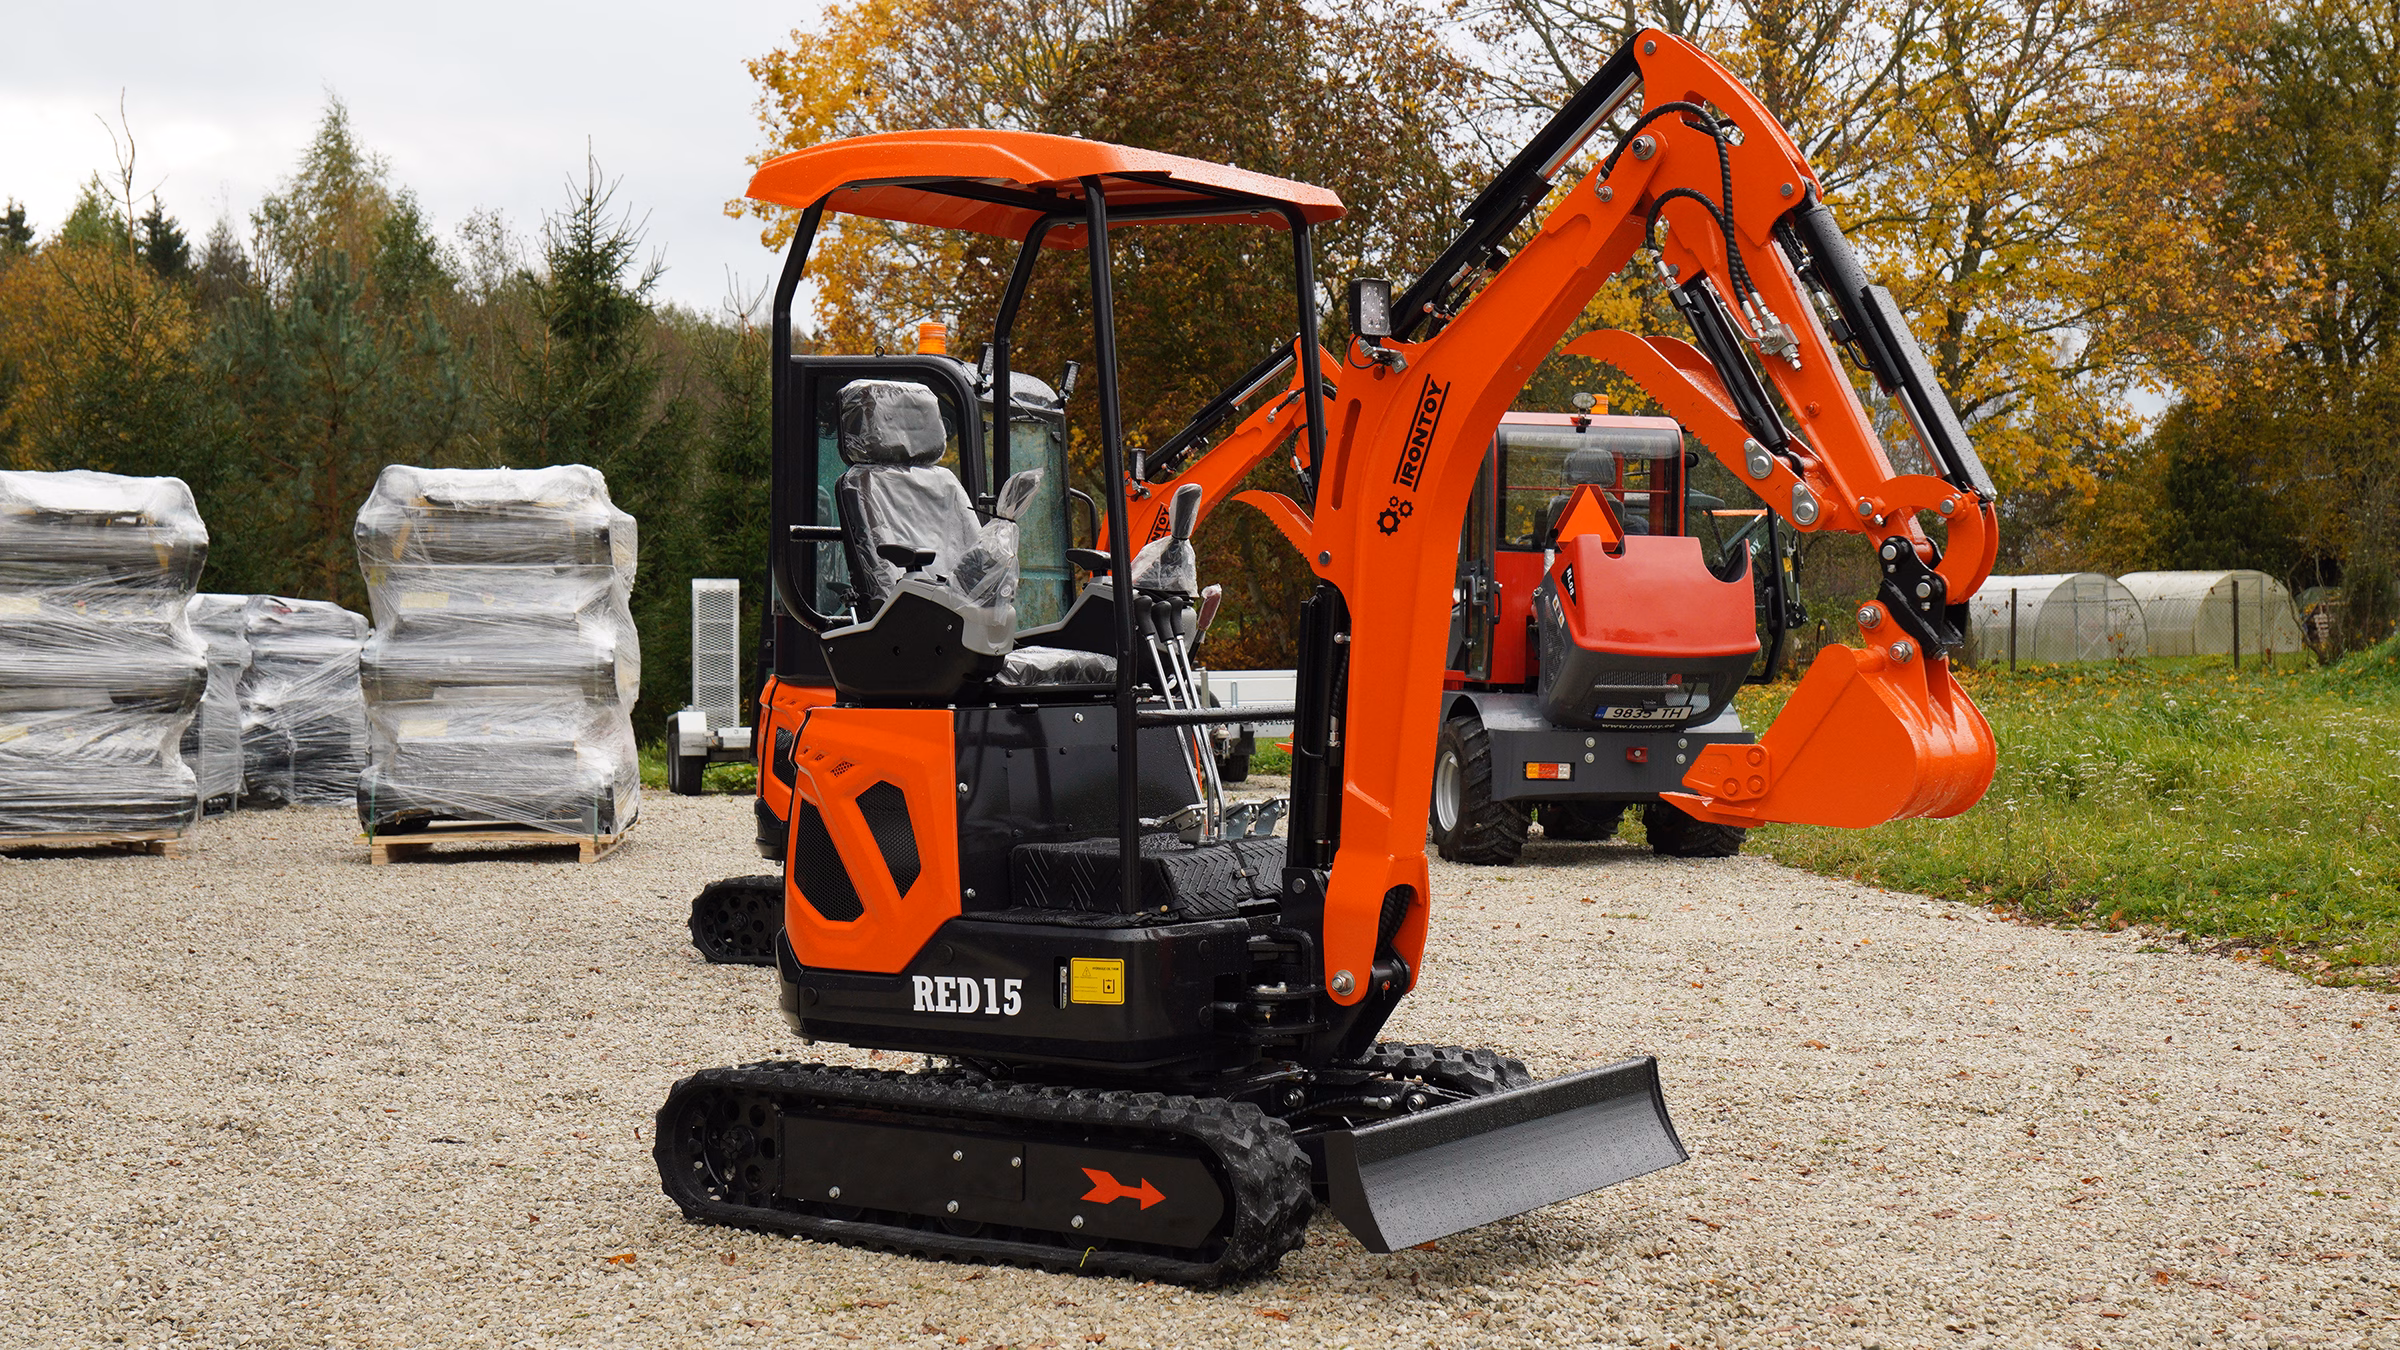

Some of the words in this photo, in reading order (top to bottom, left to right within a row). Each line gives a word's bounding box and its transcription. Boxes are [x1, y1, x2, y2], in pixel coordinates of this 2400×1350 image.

[1399, 379, 1442, 487] IRONTOY
[1151, 507, 1170, 541] NTOY
[1601, 722, 1676, 730] www.irontoy.ee
[1613, 708, 1652, 719] 9835
[1661, 708, 1684, 719] TH
[912, 975, 1022, 1016] RED15
